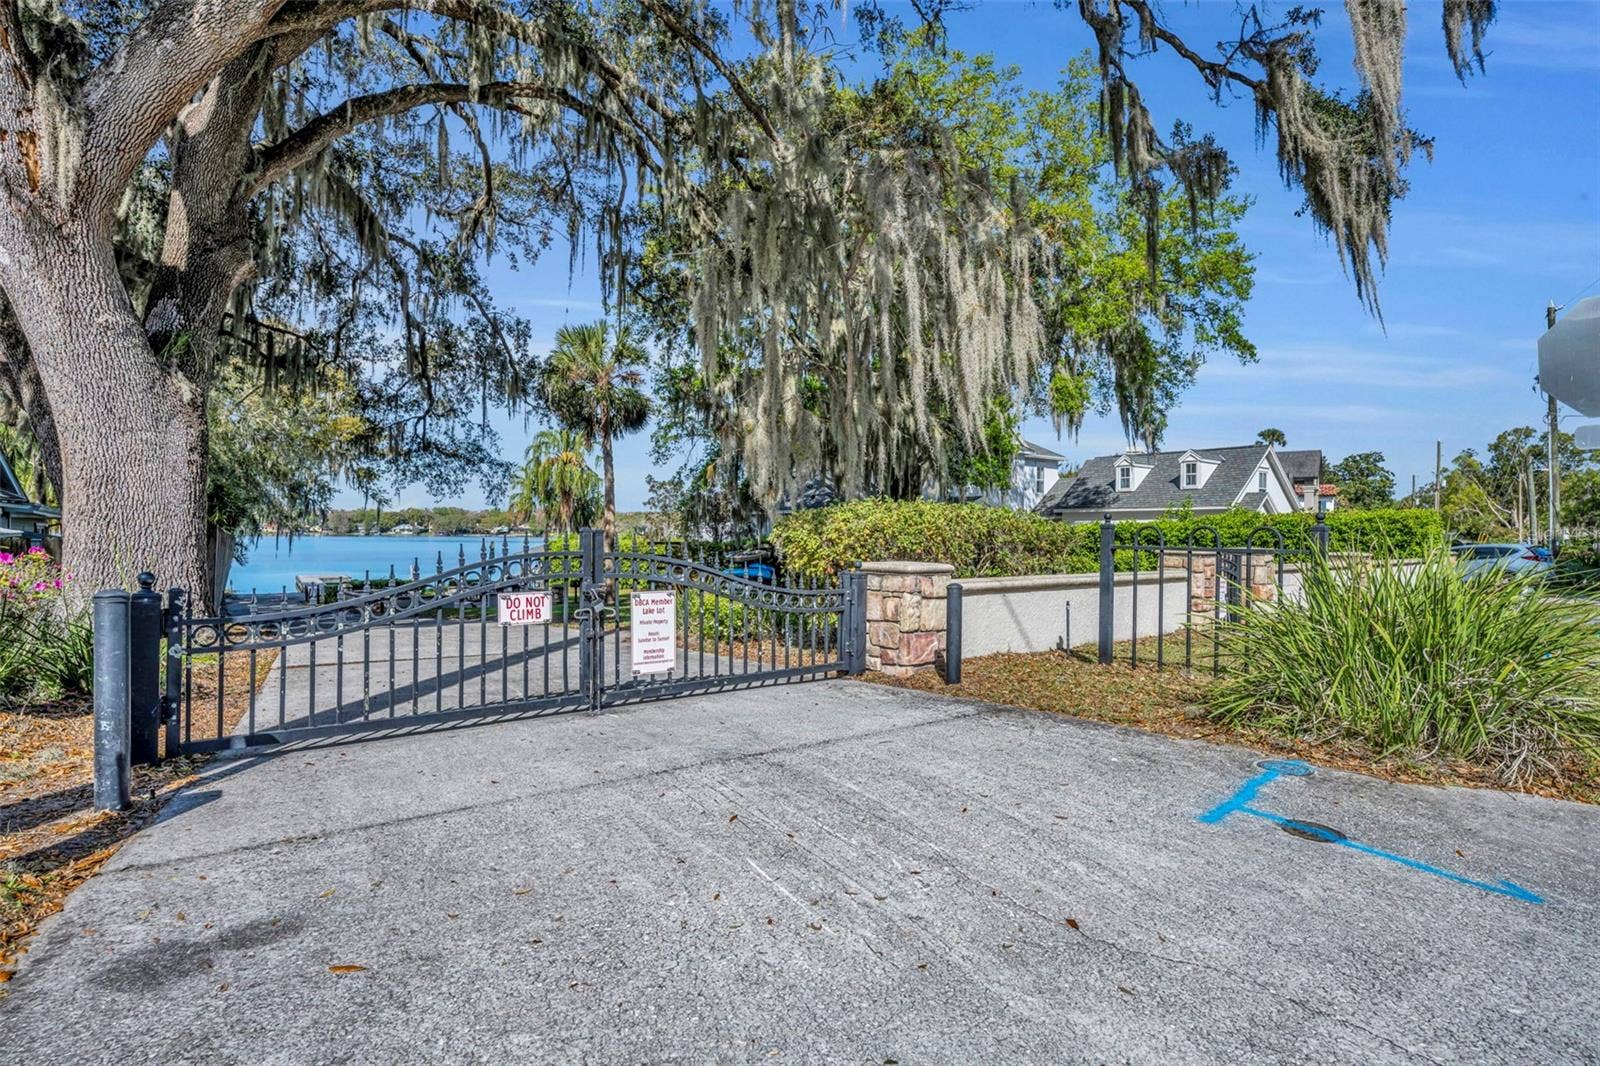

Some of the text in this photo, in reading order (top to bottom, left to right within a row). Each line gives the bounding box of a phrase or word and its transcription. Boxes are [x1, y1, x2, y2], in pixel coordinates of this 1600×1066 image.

[506, 596, 545, 609] DO NOT
[510, 608, 541, 621] CLIMB
